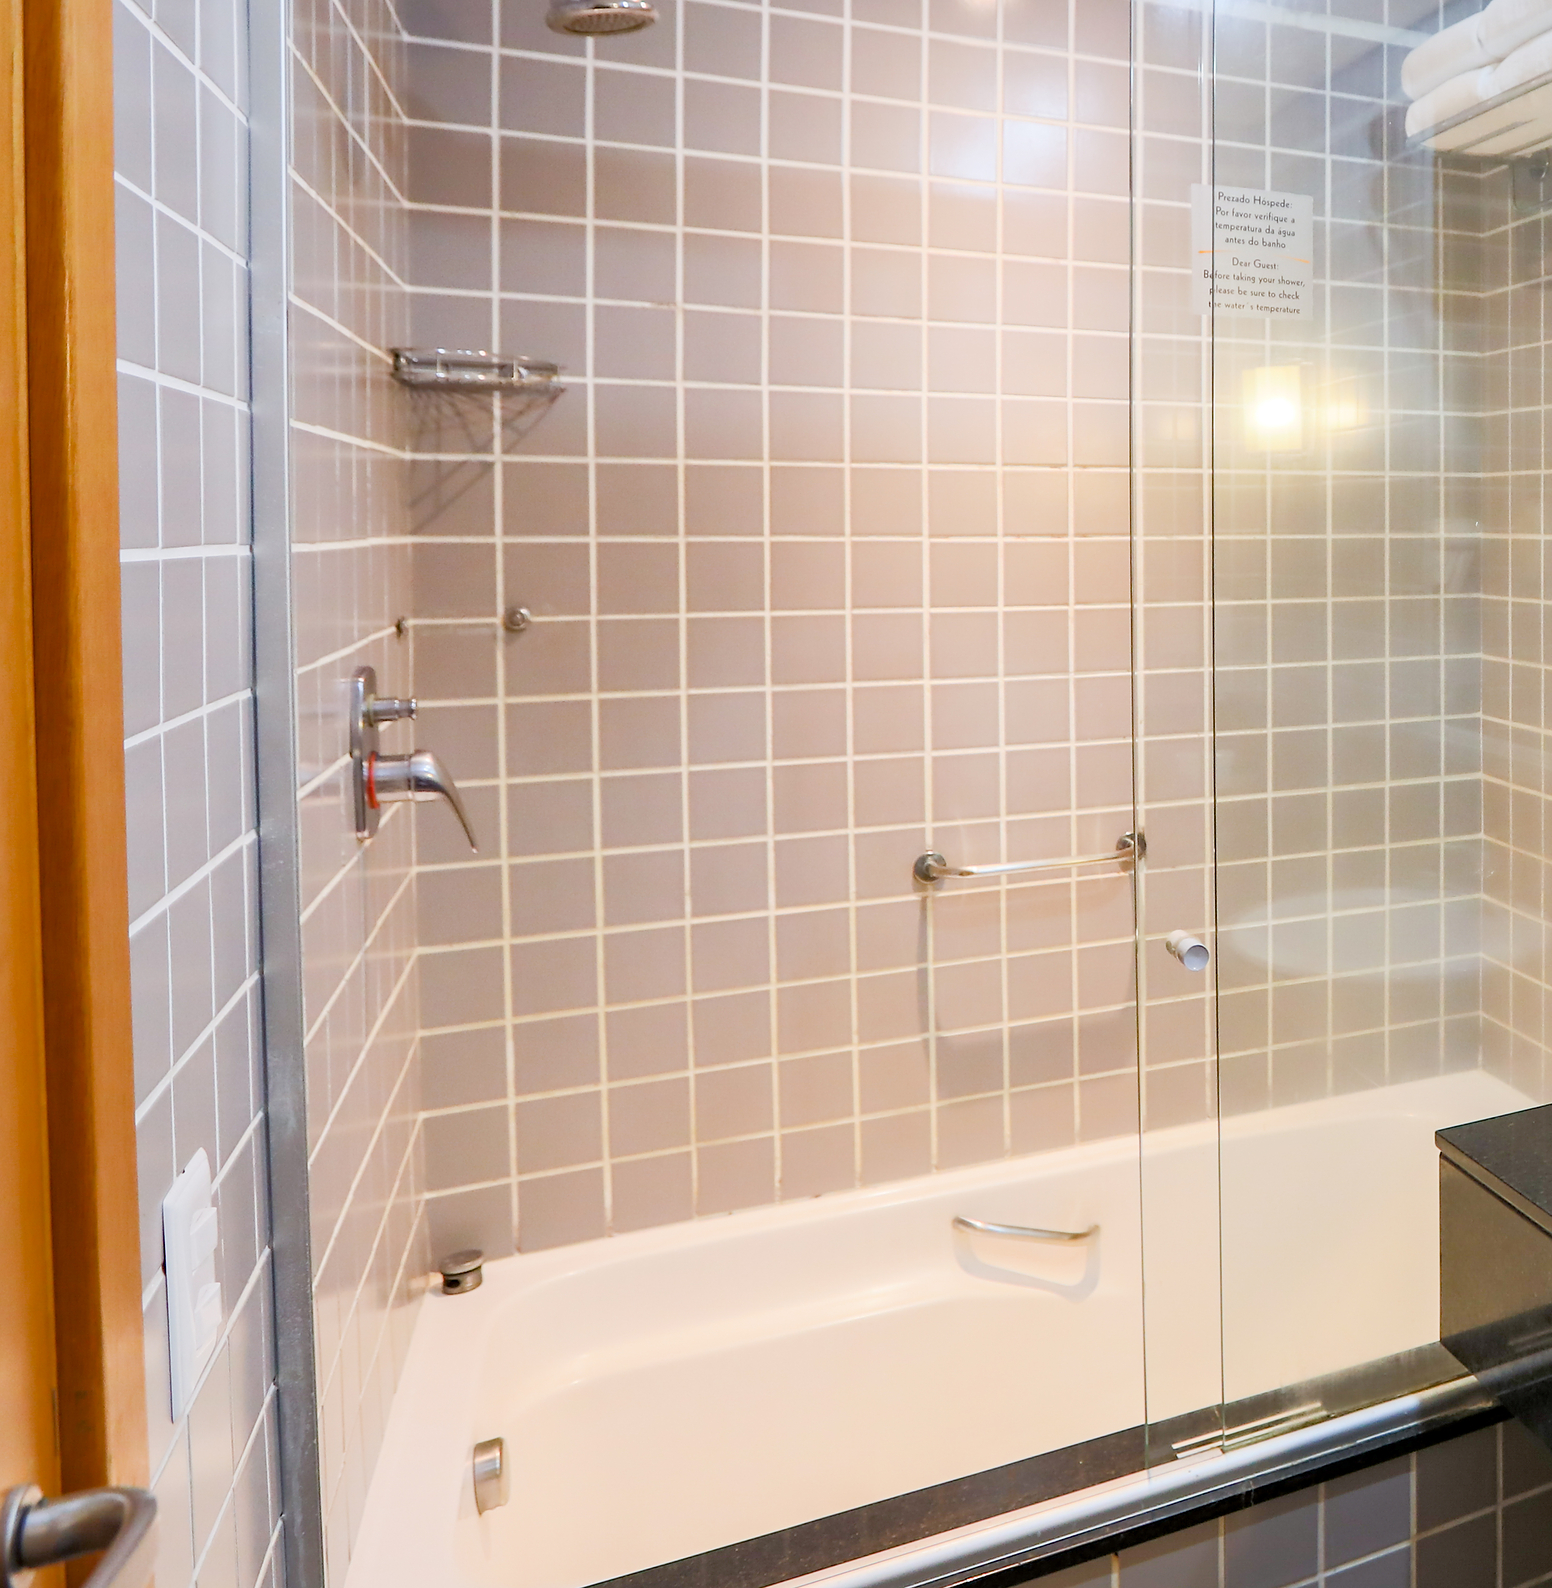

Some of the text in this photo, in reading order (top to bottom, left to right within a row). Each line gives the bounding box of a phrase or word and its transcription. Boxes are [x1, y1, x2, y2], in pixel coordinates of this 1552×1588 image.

[1218, 191, 1293, 209] Prezado Hóspede:
[1216, 206, 1229, 216] Por
[1232, 207, 1251, 219] favor
[1254, 212, 1288, 224] verifique
[1215, 222, 1296, 238] temperatura da água
[1225, 236, 1286, 249] antes do banho
[1232, 257, 1279, 271] Dear Guest:
[1233, 272, 1256, 283] taking
[1258, 276, 1275, 284] your
[1277, 275, 1306, 288] shower,
[1237, 286, 1248, 296] be
[1250, 290, 1266, 298] sure
[1268, 290, 1277, 299] to
[1278, 289, 1300, 300] check
[1256, 303, 1301, 315] temperature
